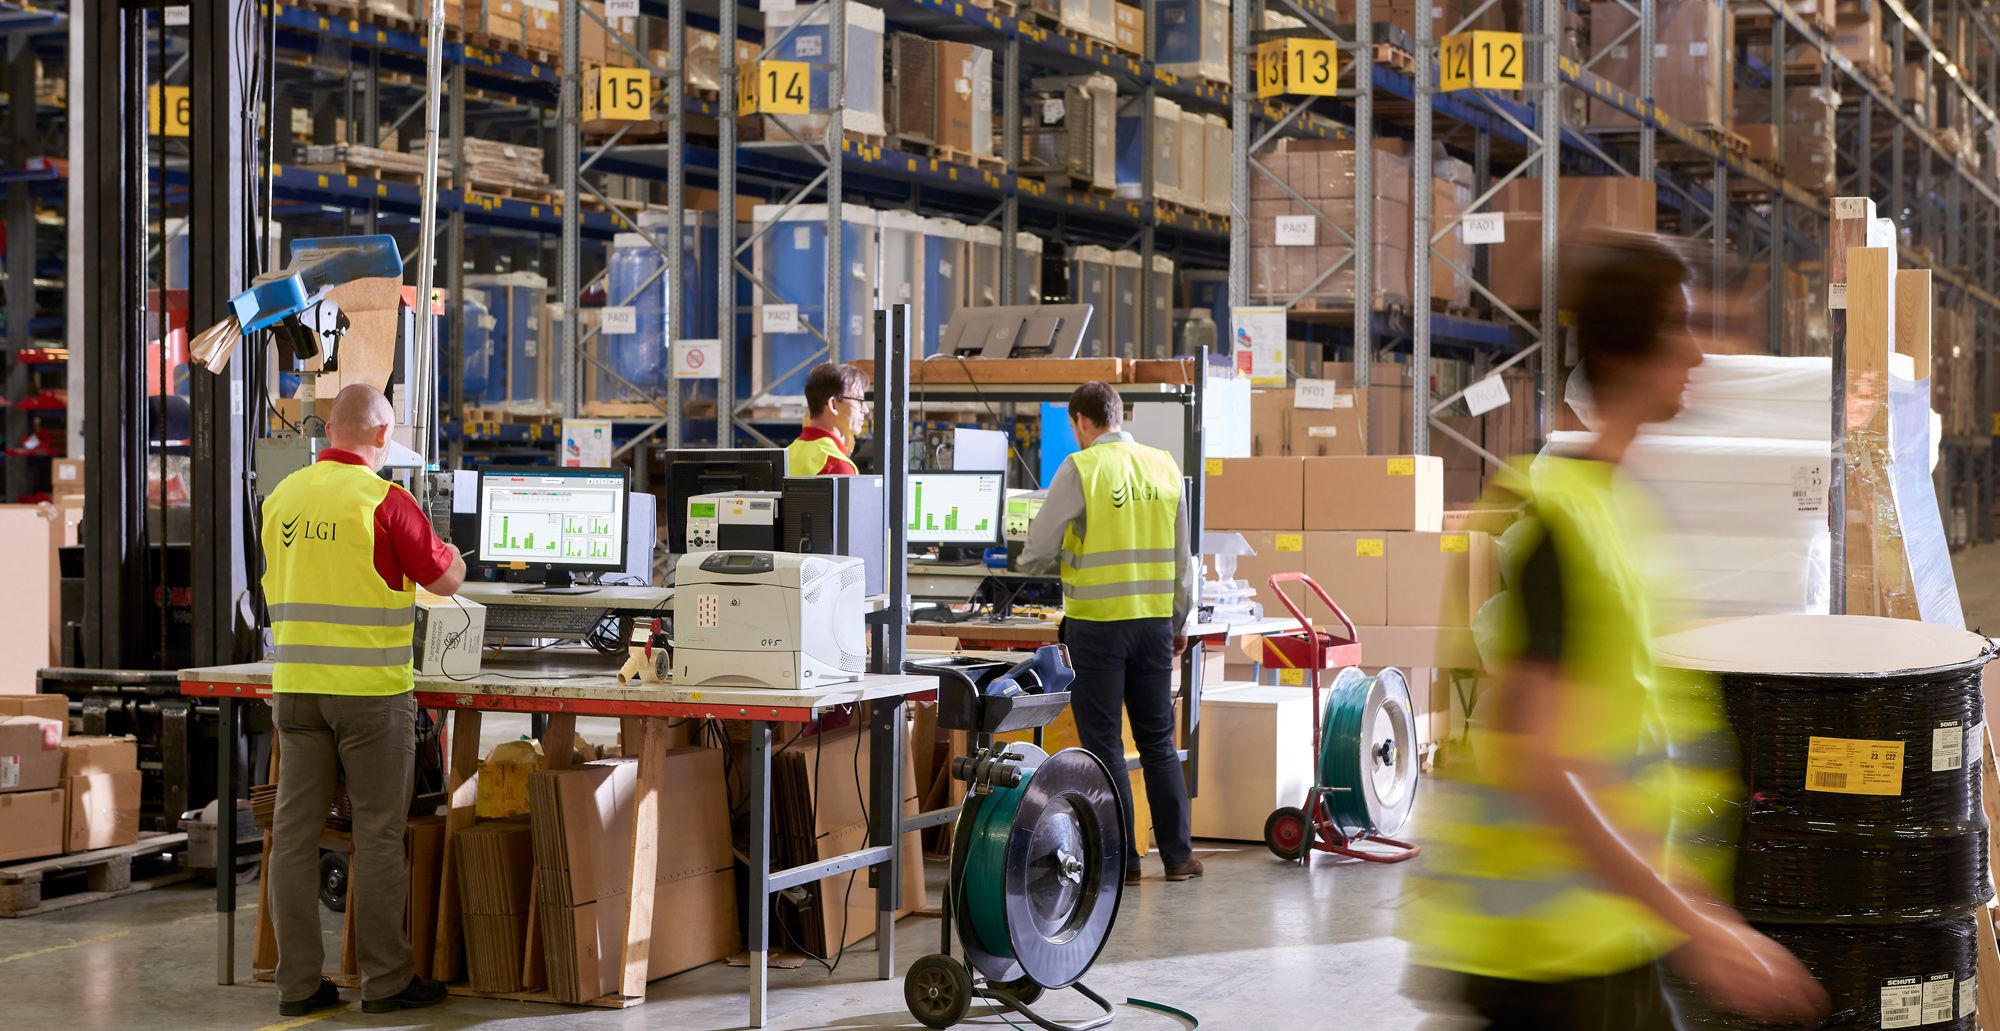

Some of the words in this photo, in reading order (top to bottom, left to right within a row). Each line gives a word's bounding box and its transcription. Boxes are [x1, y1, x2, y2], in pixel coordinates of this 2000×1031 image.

[1261, 51, 1279, 87] 13
[1295, 49, 1330, 84] 13
[1445, 43, 1466, 81] 12
[1481, 42, 1516, 79] 12
[608, 77, 643, 110] 15
[768, 71, 804, 105] 14
[1282, 223, 1308, 234] PA02
[1469, 220, 1496, 232] PA01
[607, 313, 630, 324] PA02
[767, 311, 791, 322] PA02
[1131, 486, 1159, 501] LGI
[304, 520, 337, 541] LGI
[1885, 753, 1897, 761] C22
